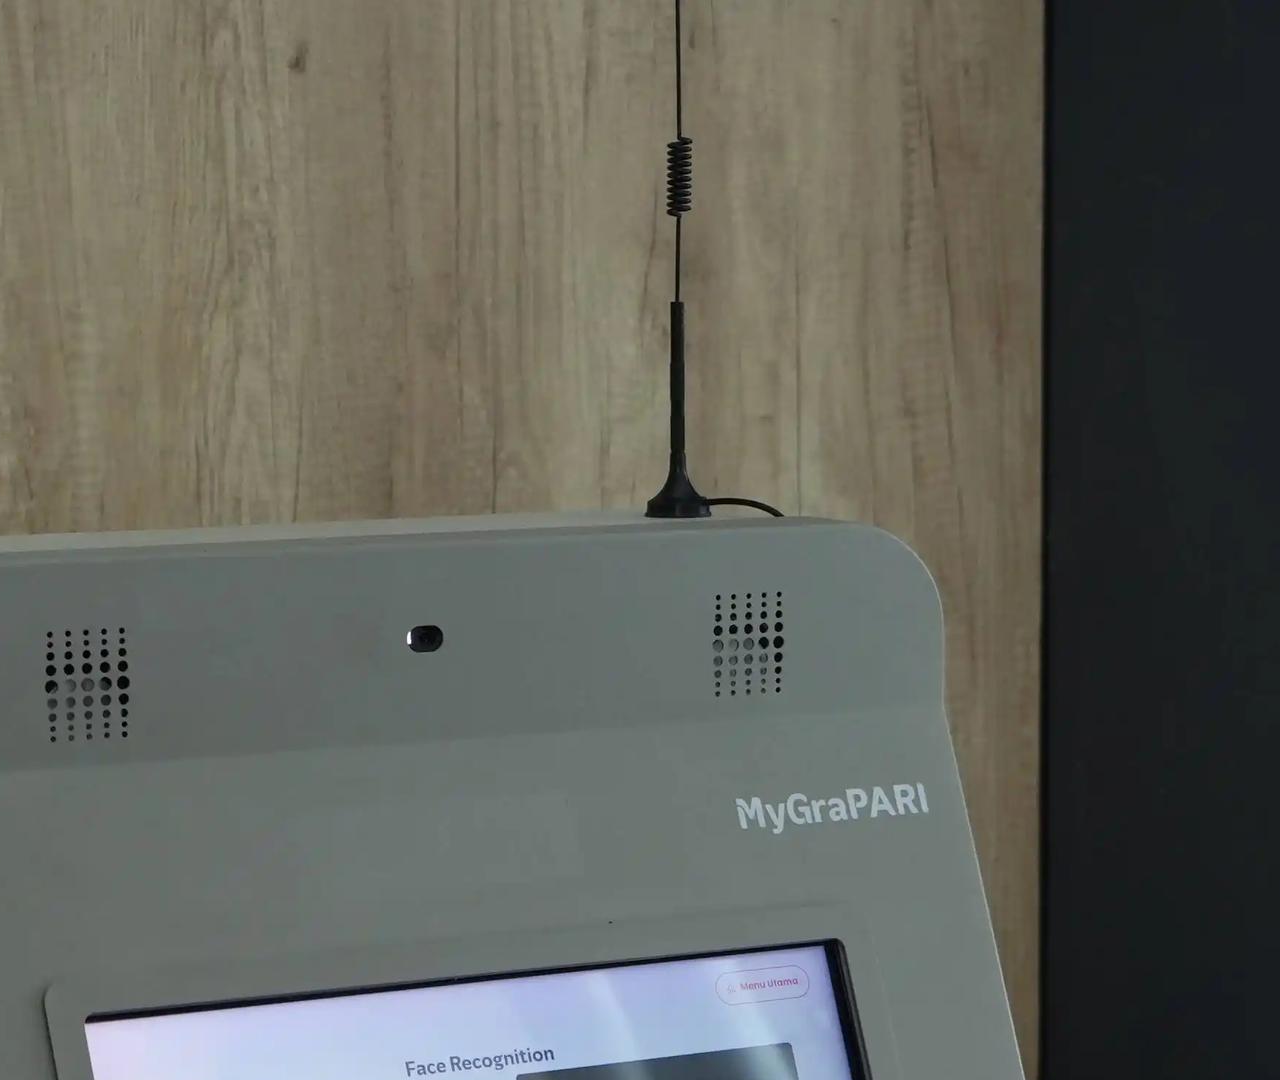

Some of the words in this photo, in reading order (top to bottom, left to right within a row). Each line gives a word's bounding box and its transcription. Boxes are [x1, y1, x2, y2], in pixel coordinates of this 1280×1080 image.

[735, 782, 929, 834] MyGraPARI
[740, 982, 766, 991] Menu
[767, 978, 799, 988] Utama
[405, 1061, 447, 1077] Face
[449, 1048, 555, 1072] Recognition
